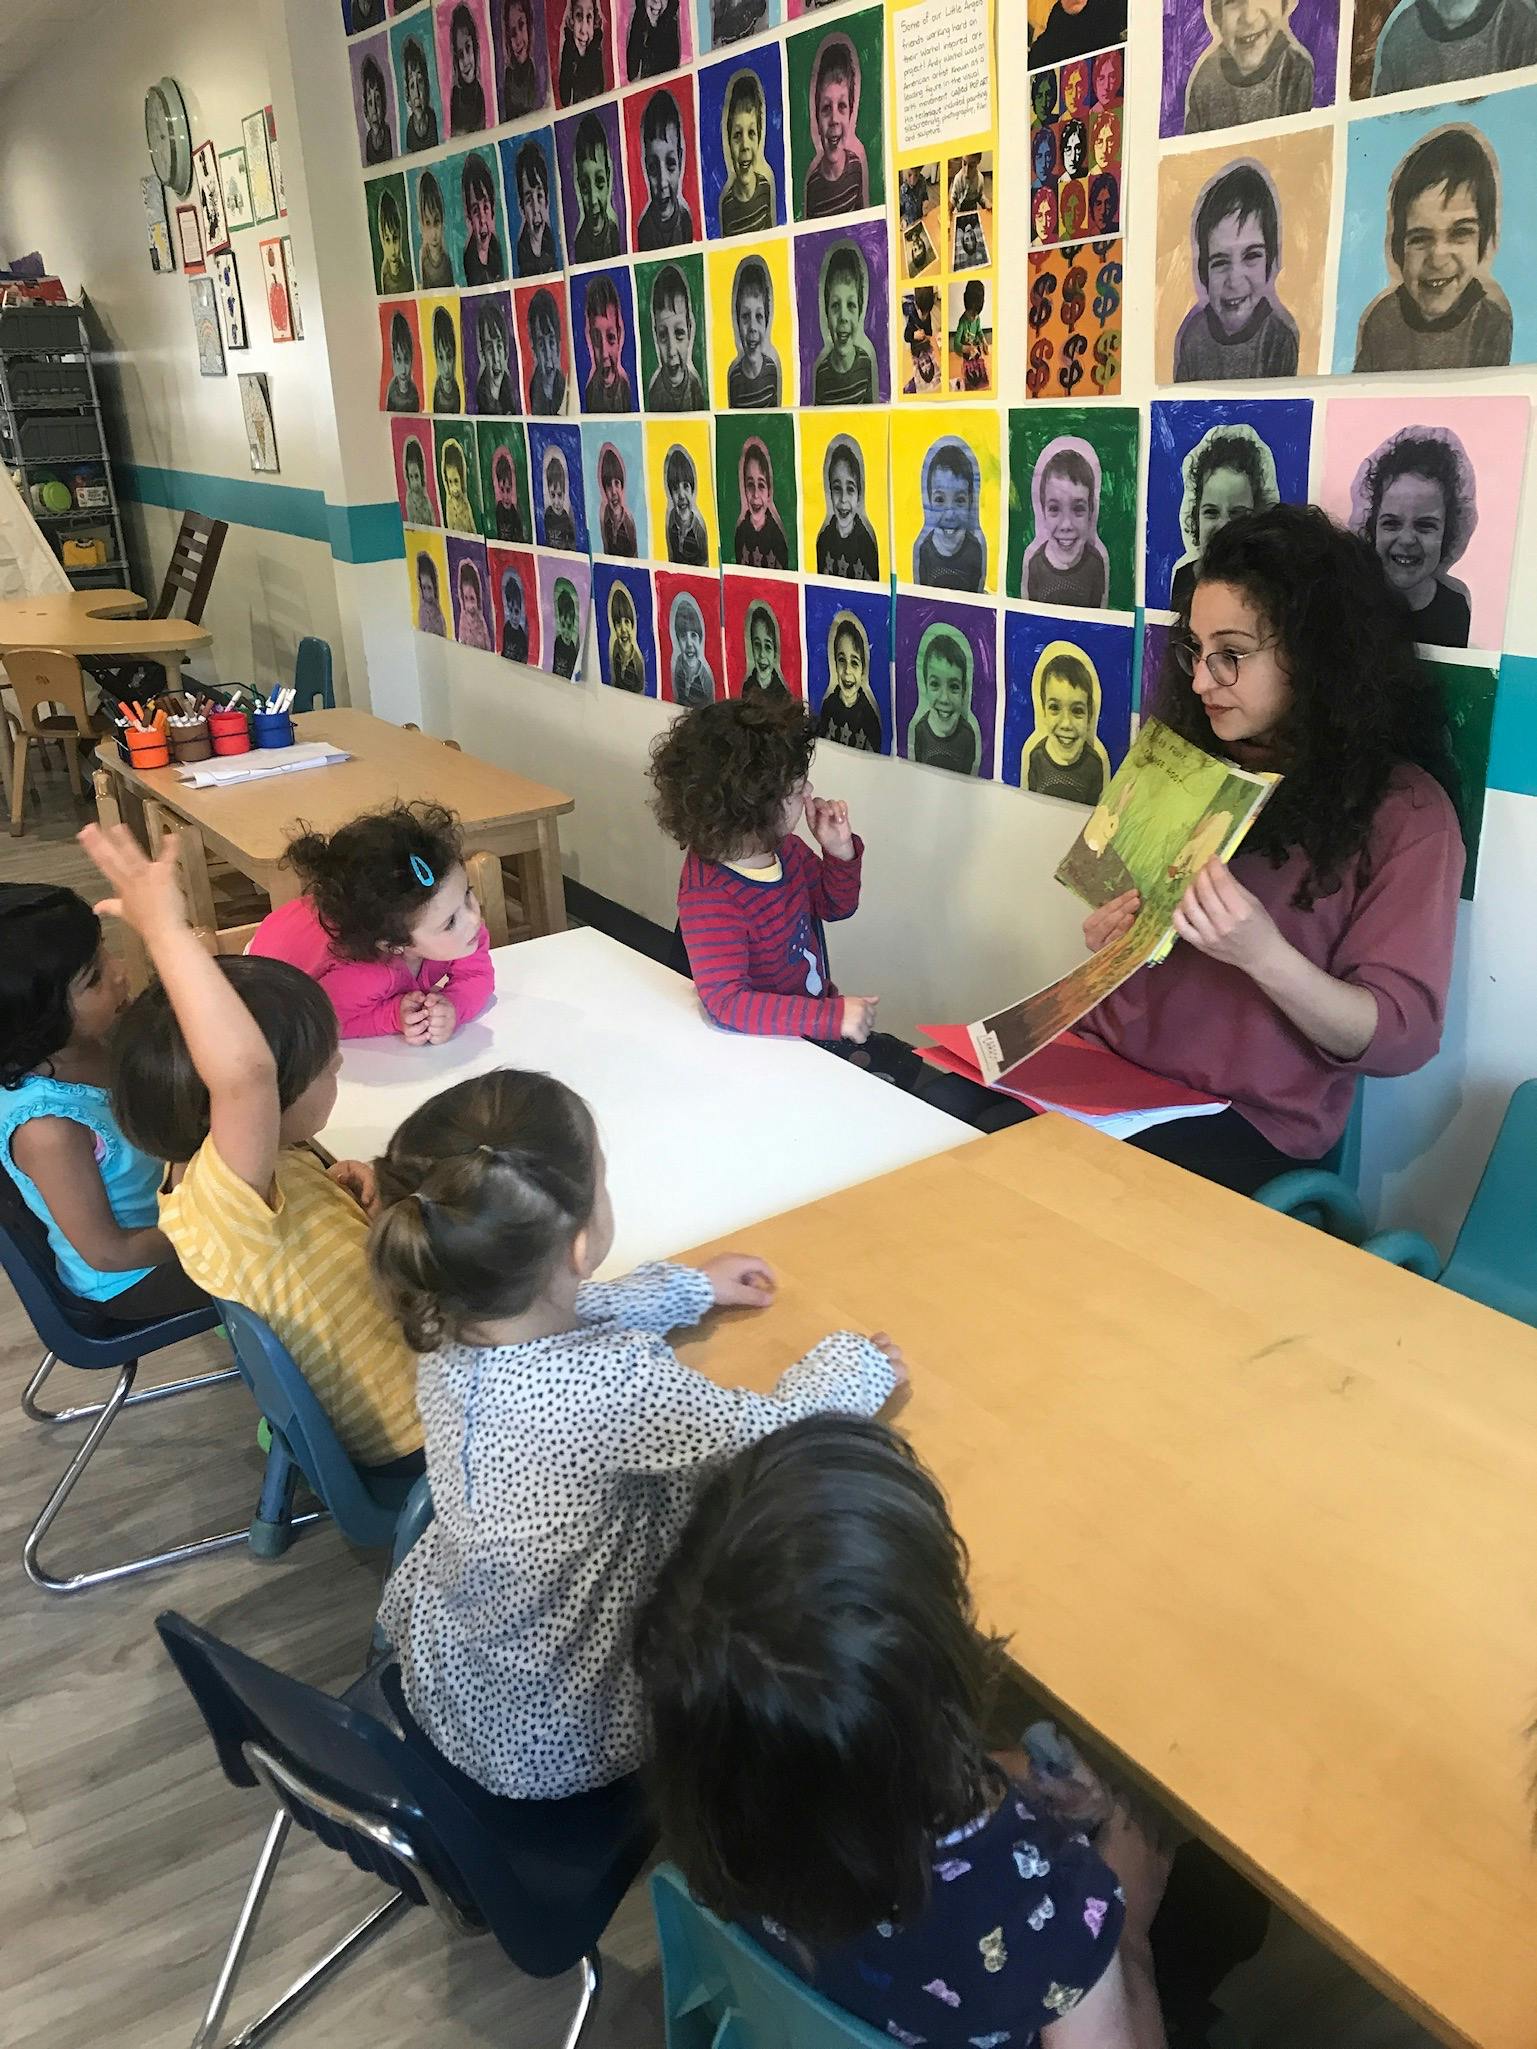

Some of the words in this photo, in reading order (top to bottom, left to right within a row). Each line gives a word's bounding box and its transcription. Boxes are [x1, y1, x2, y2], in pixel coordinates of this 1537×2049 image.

[901, 19, 920, 33] Some
[923, 11, 928, 24] of
[932, 12, 941, 22] our
[945, 3, 962, 16] Little
[902, 35, 924, 49] friends
[927, 27, 951, 41] working
[952, 19, 967, 32] hard
[969, 18, 977, 26] on
[903, 54, 918, 63] their
[920, 42, 940, 57] Warhol
[943, 34, 968, 50] inspired
[972, 32, 982, 40] art
[928, 57, 942, 69] Andy
[965, 46, 978, 56] was
[904, 76, 930, 90] American
[971, 57, 979, 66] as
[904, 90, 924, 101] leading
[925, 83, 942, 96] figure
[963, 69, 979, 80] visual
[919, 92, 947, 107] movement
[951, 86, 968, 97] called
